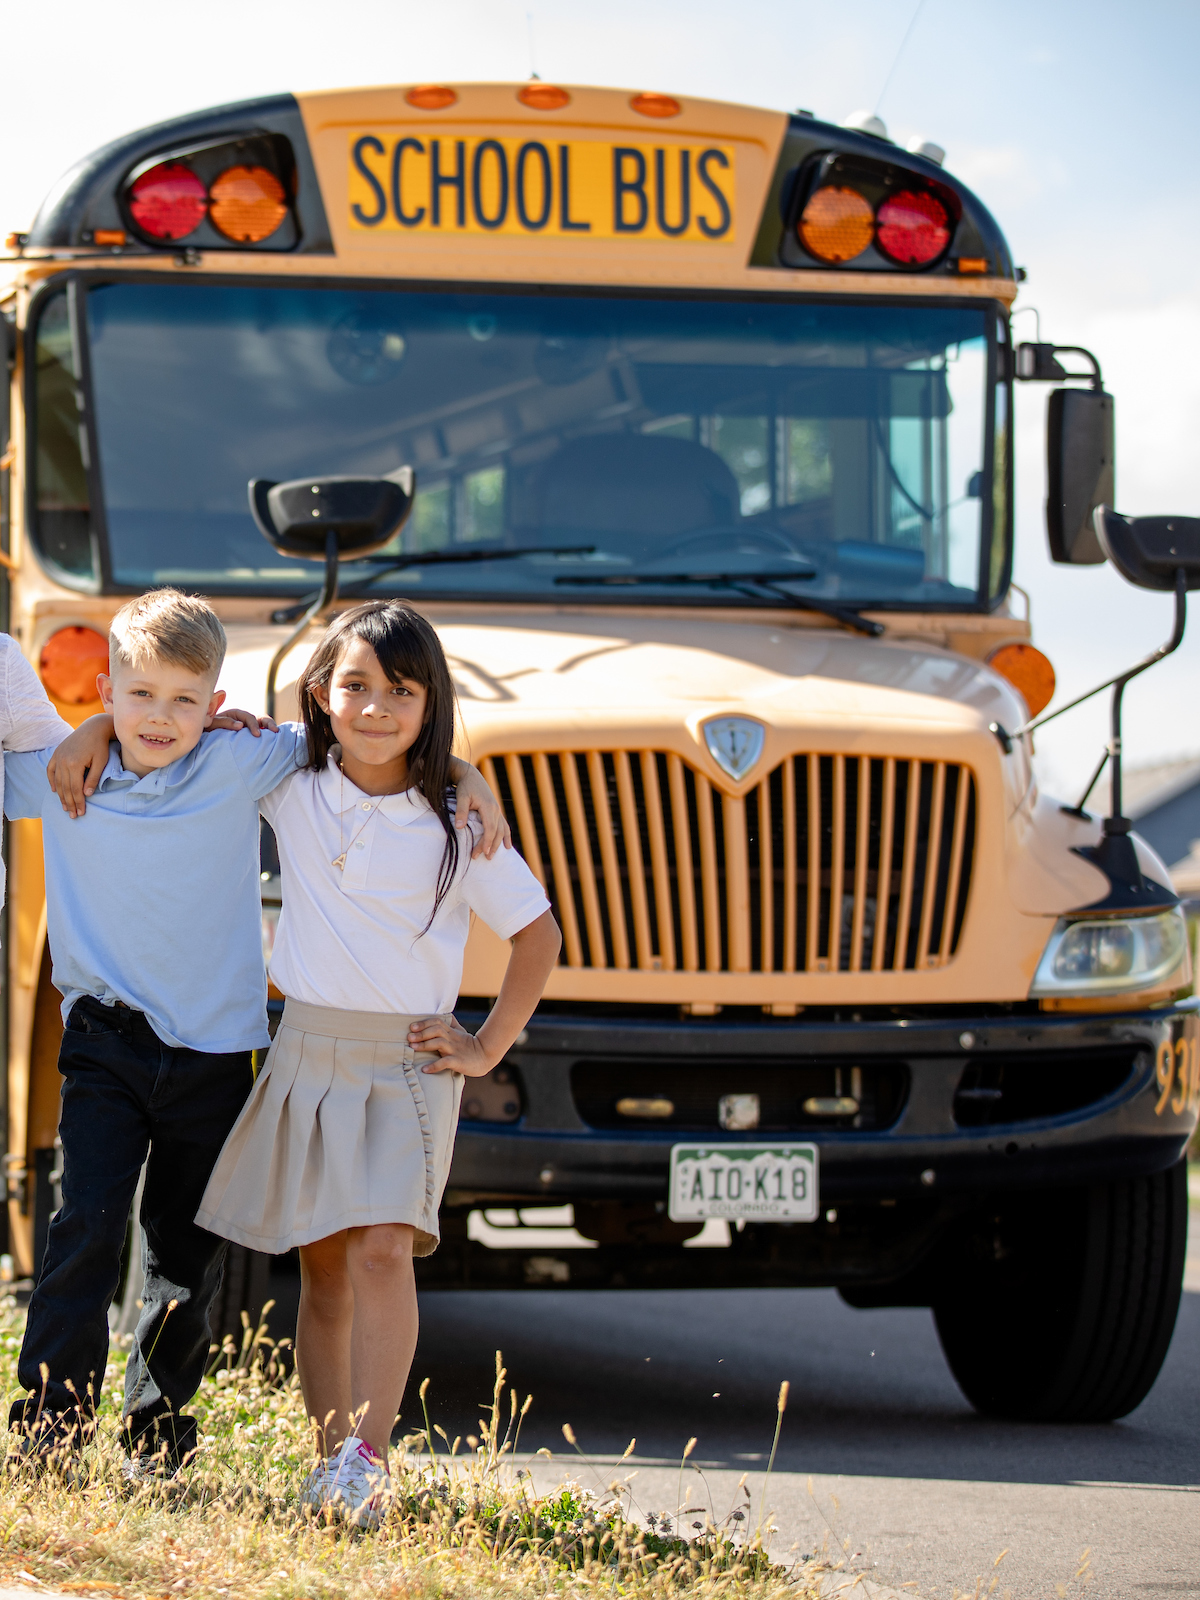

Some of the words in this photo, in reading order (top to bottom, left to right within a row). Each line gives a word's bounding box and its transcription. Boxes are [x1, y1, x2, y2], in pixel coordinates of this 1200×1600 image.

[351, 135, 591, 231] SCHOOL
[613, 147, 731, 238] BUS
[709, 1203, 779, 1215] COLORADO
